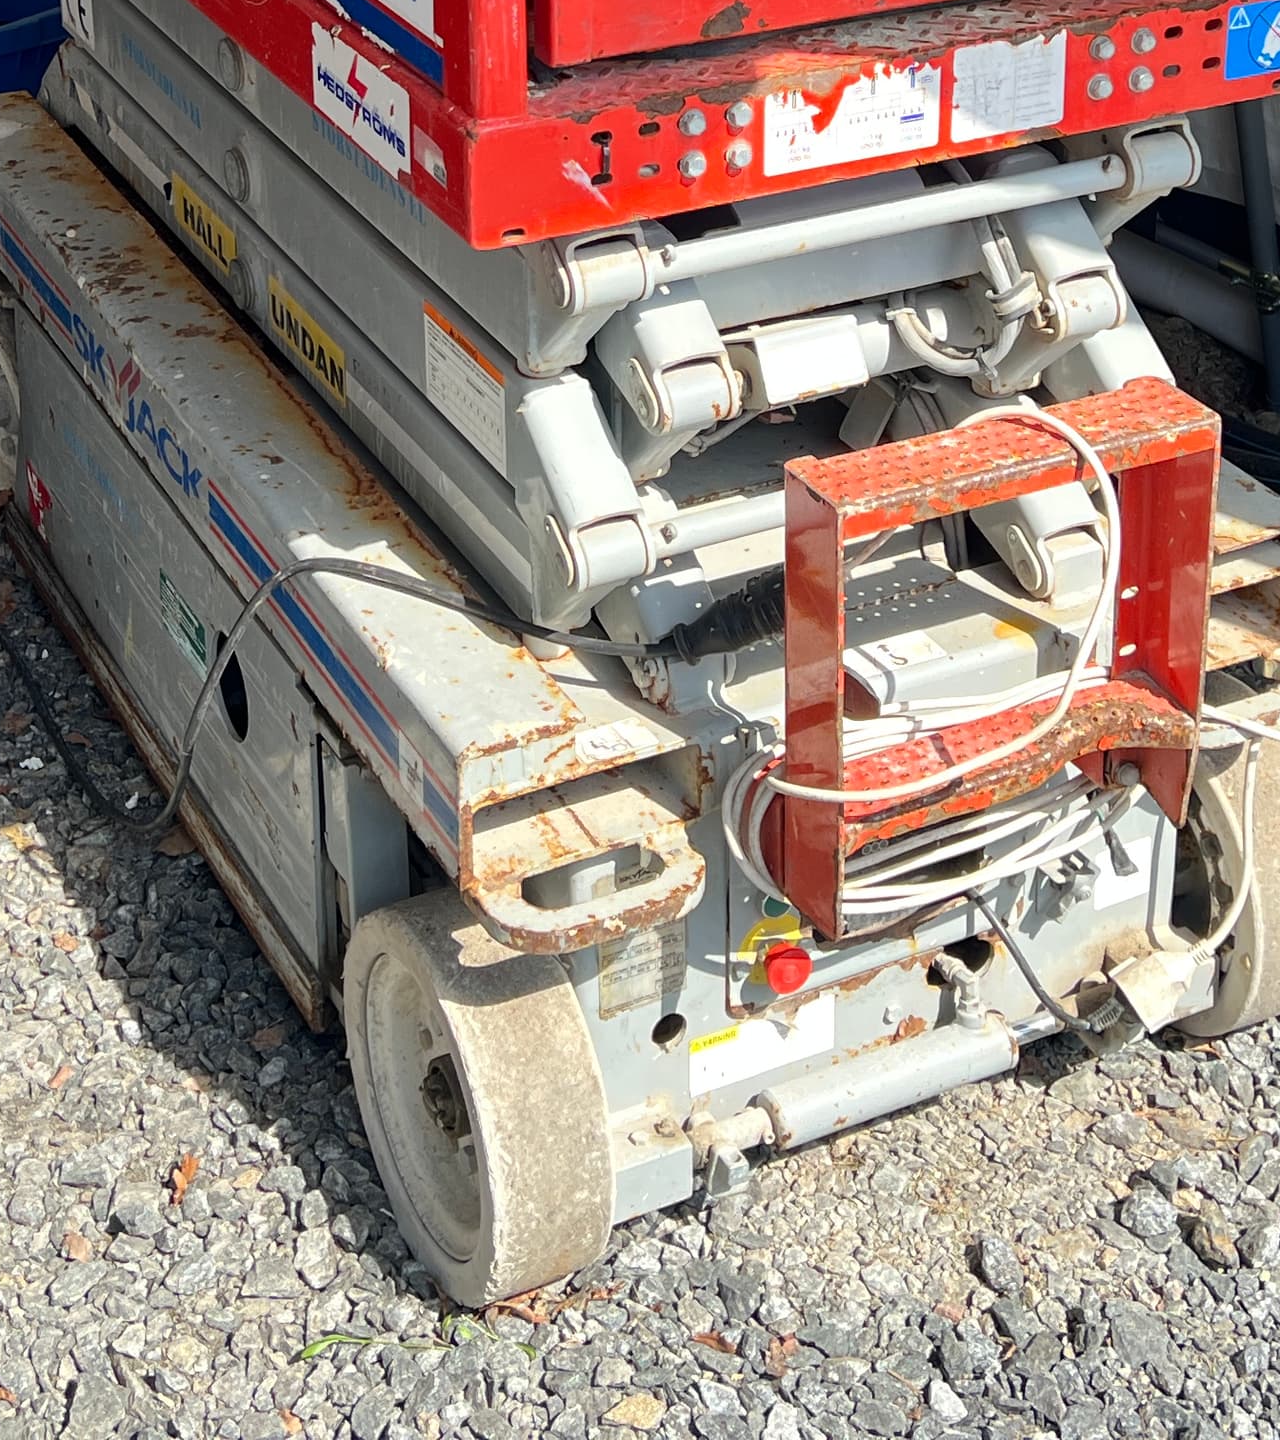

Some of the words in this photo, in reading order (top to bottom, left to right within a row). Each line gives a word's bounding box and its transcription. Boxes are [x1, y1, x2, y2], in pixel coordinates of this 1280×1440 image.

[317, 64, 406, 158] HEDSTRÖMS
[182, 196, 229, 268] HÅLL
[270, 293, 345, 398] UNDAN
